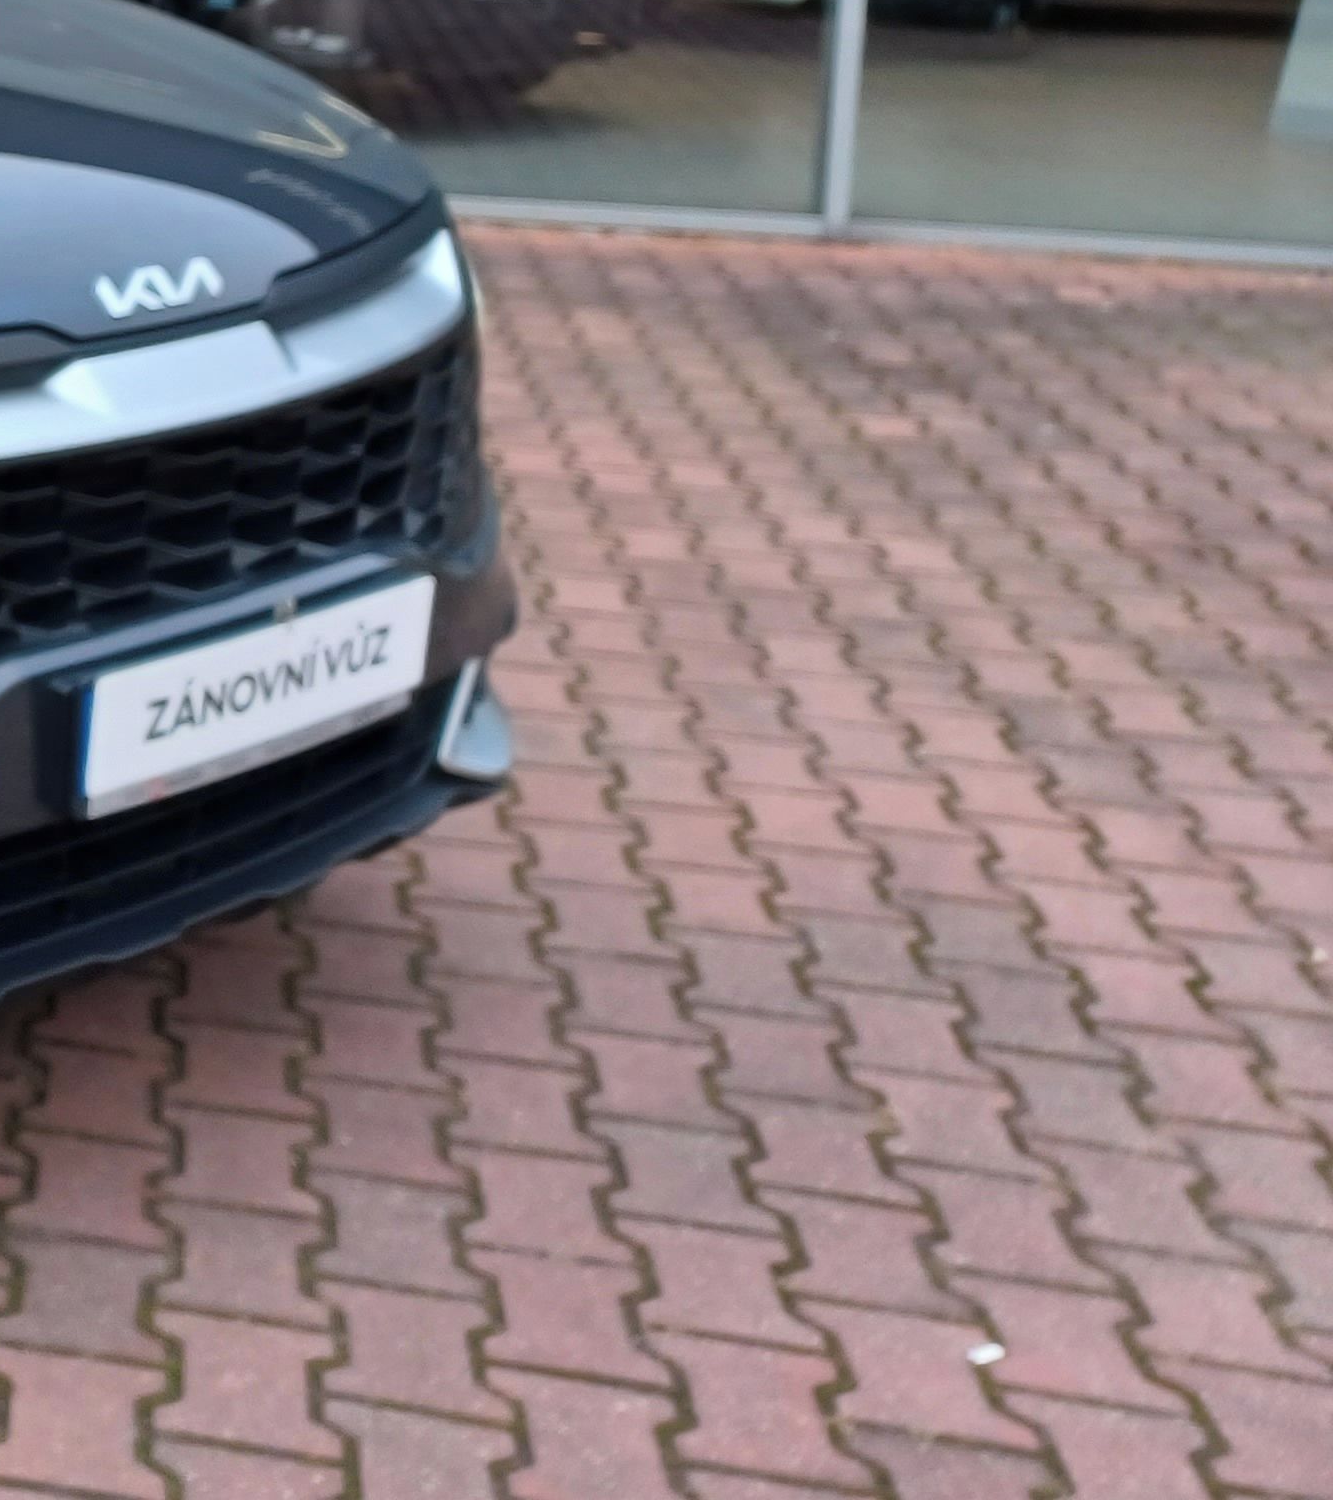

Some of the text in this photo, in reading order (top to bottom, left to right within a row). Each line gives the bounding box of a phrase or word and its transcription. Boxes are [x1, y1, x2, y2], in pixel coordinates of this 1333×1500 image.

[94, 255, 225, 320] KIA
[145, 620, 391, 741] ZÁNOVNÍ VŮZ
